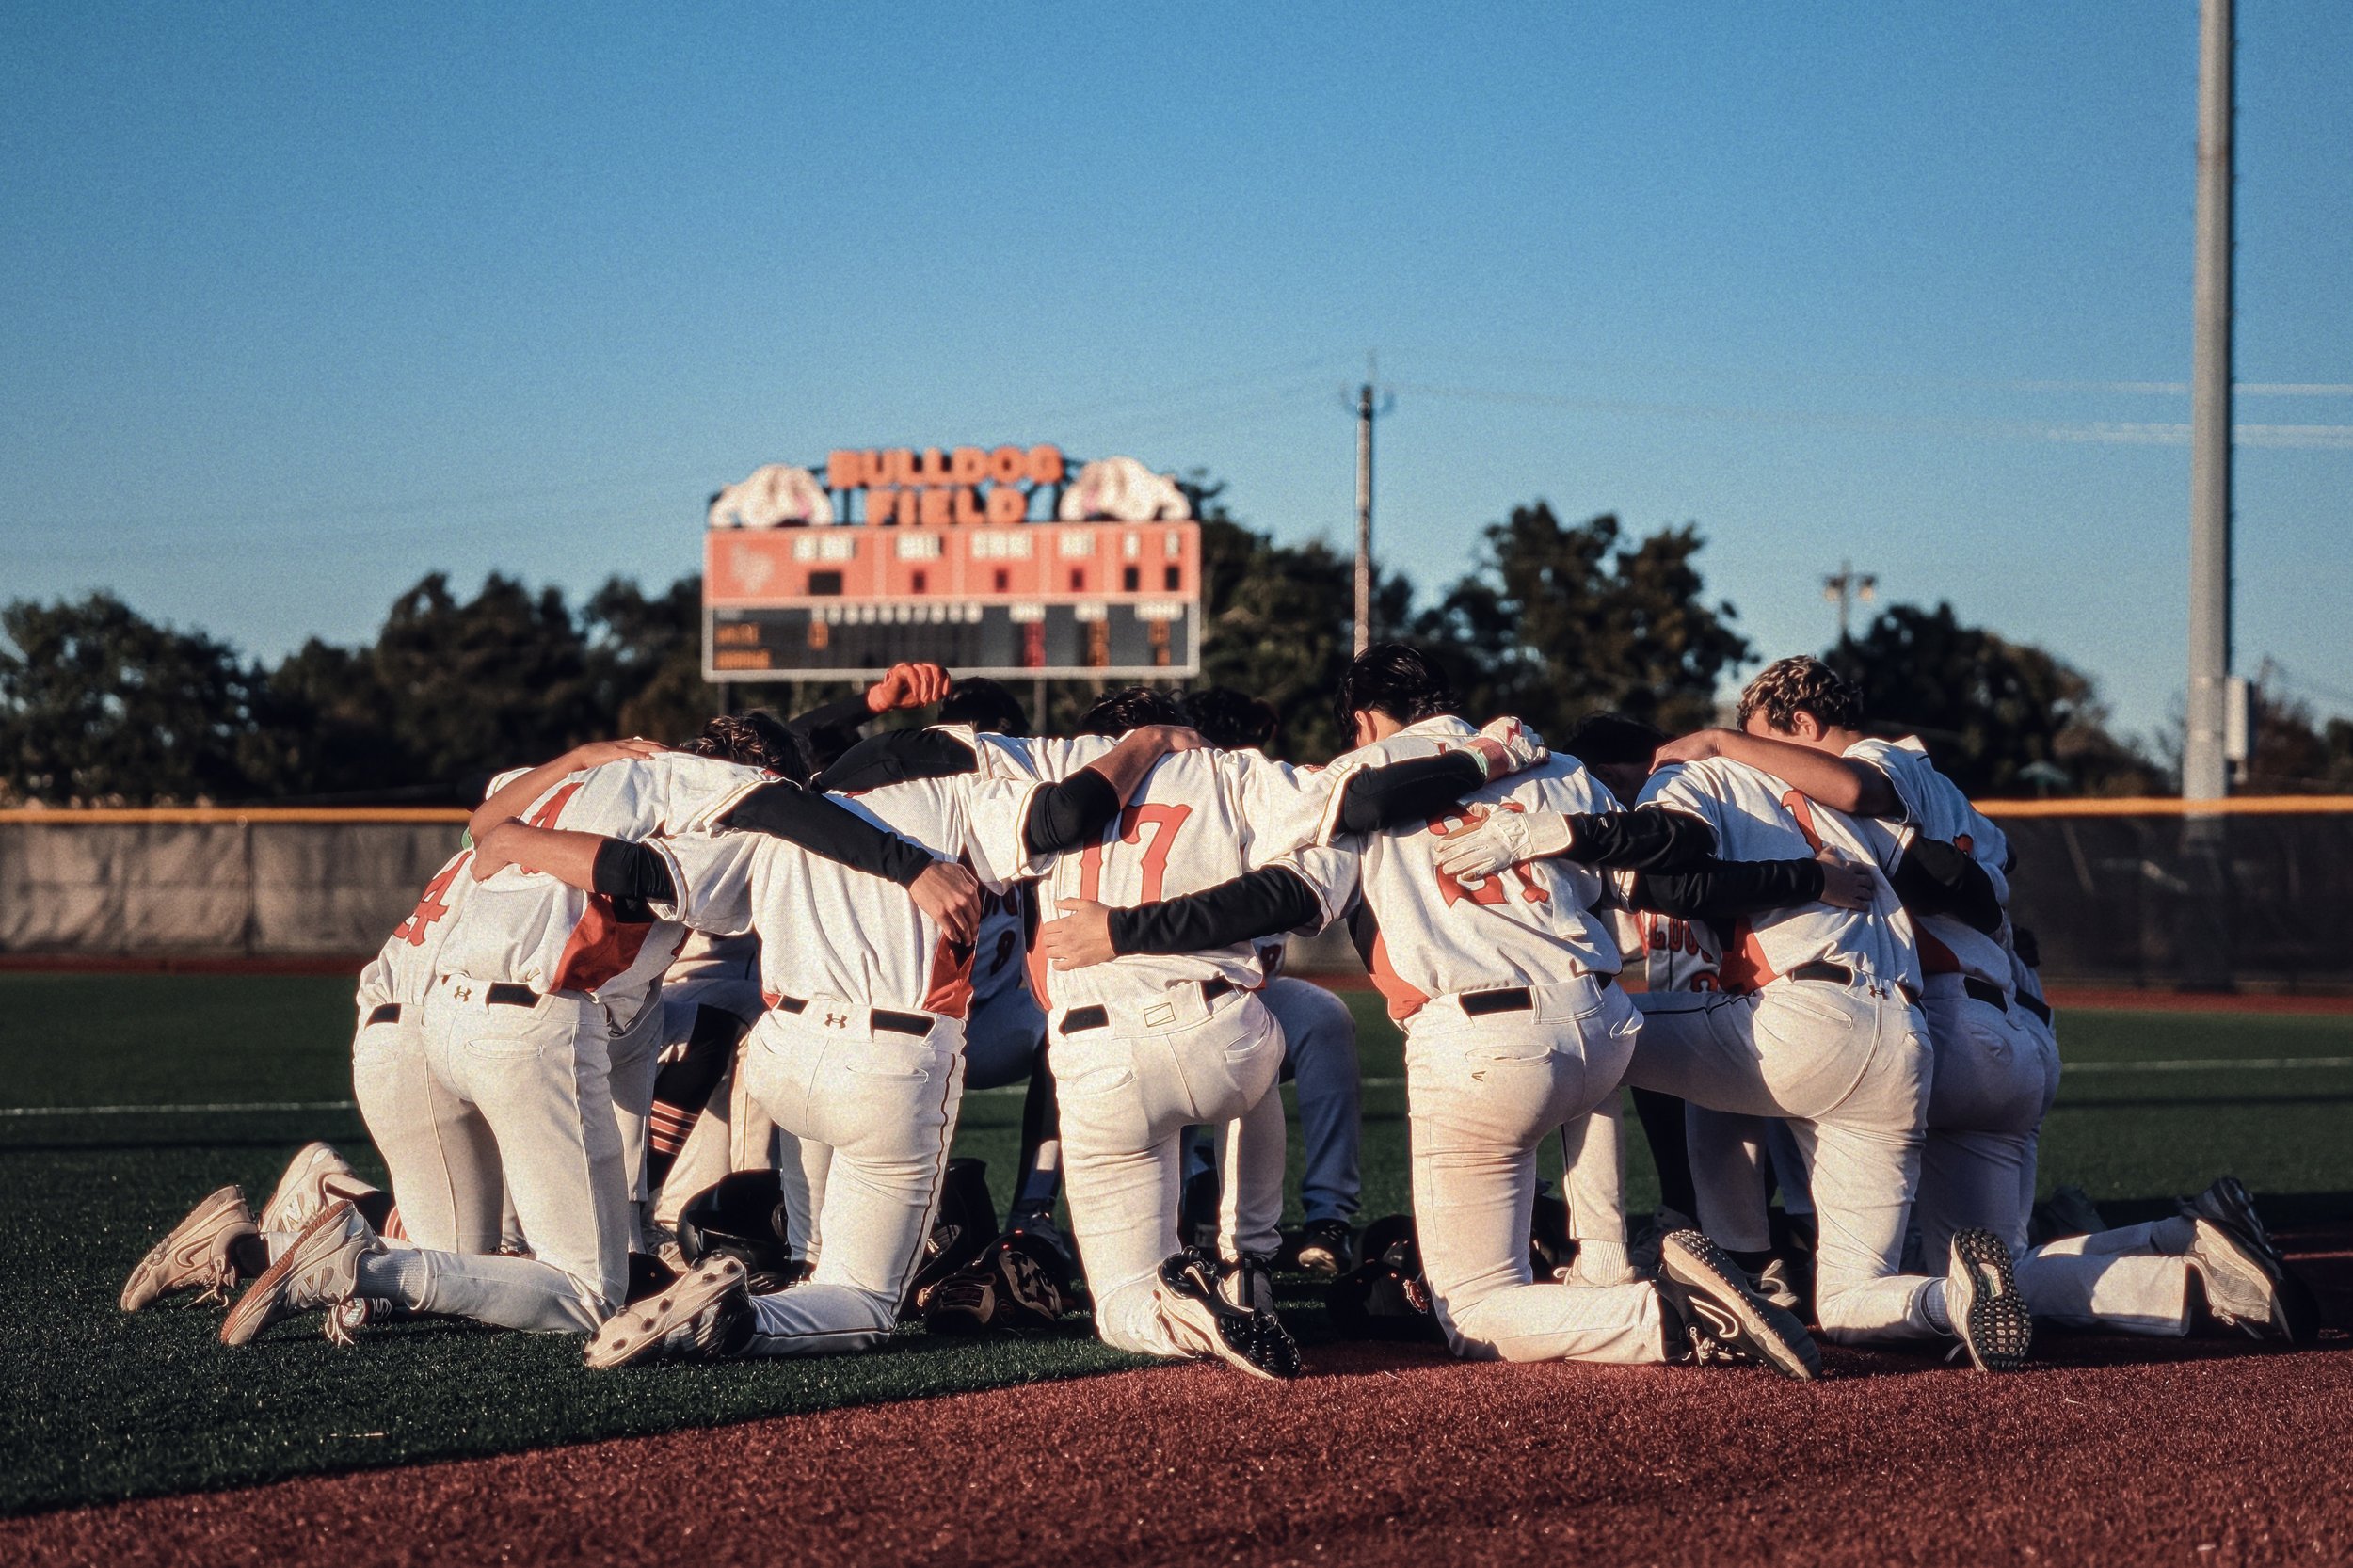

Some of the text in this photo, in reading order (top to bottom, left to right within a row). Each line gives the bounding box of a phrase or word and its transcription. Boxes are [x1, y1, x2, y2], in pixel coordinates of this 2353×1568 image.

[828, 446, 1063, 488] BULLDOG
[865, 486, 1027, 524] FIELD
[1080, 803, 1193, 905] 17
